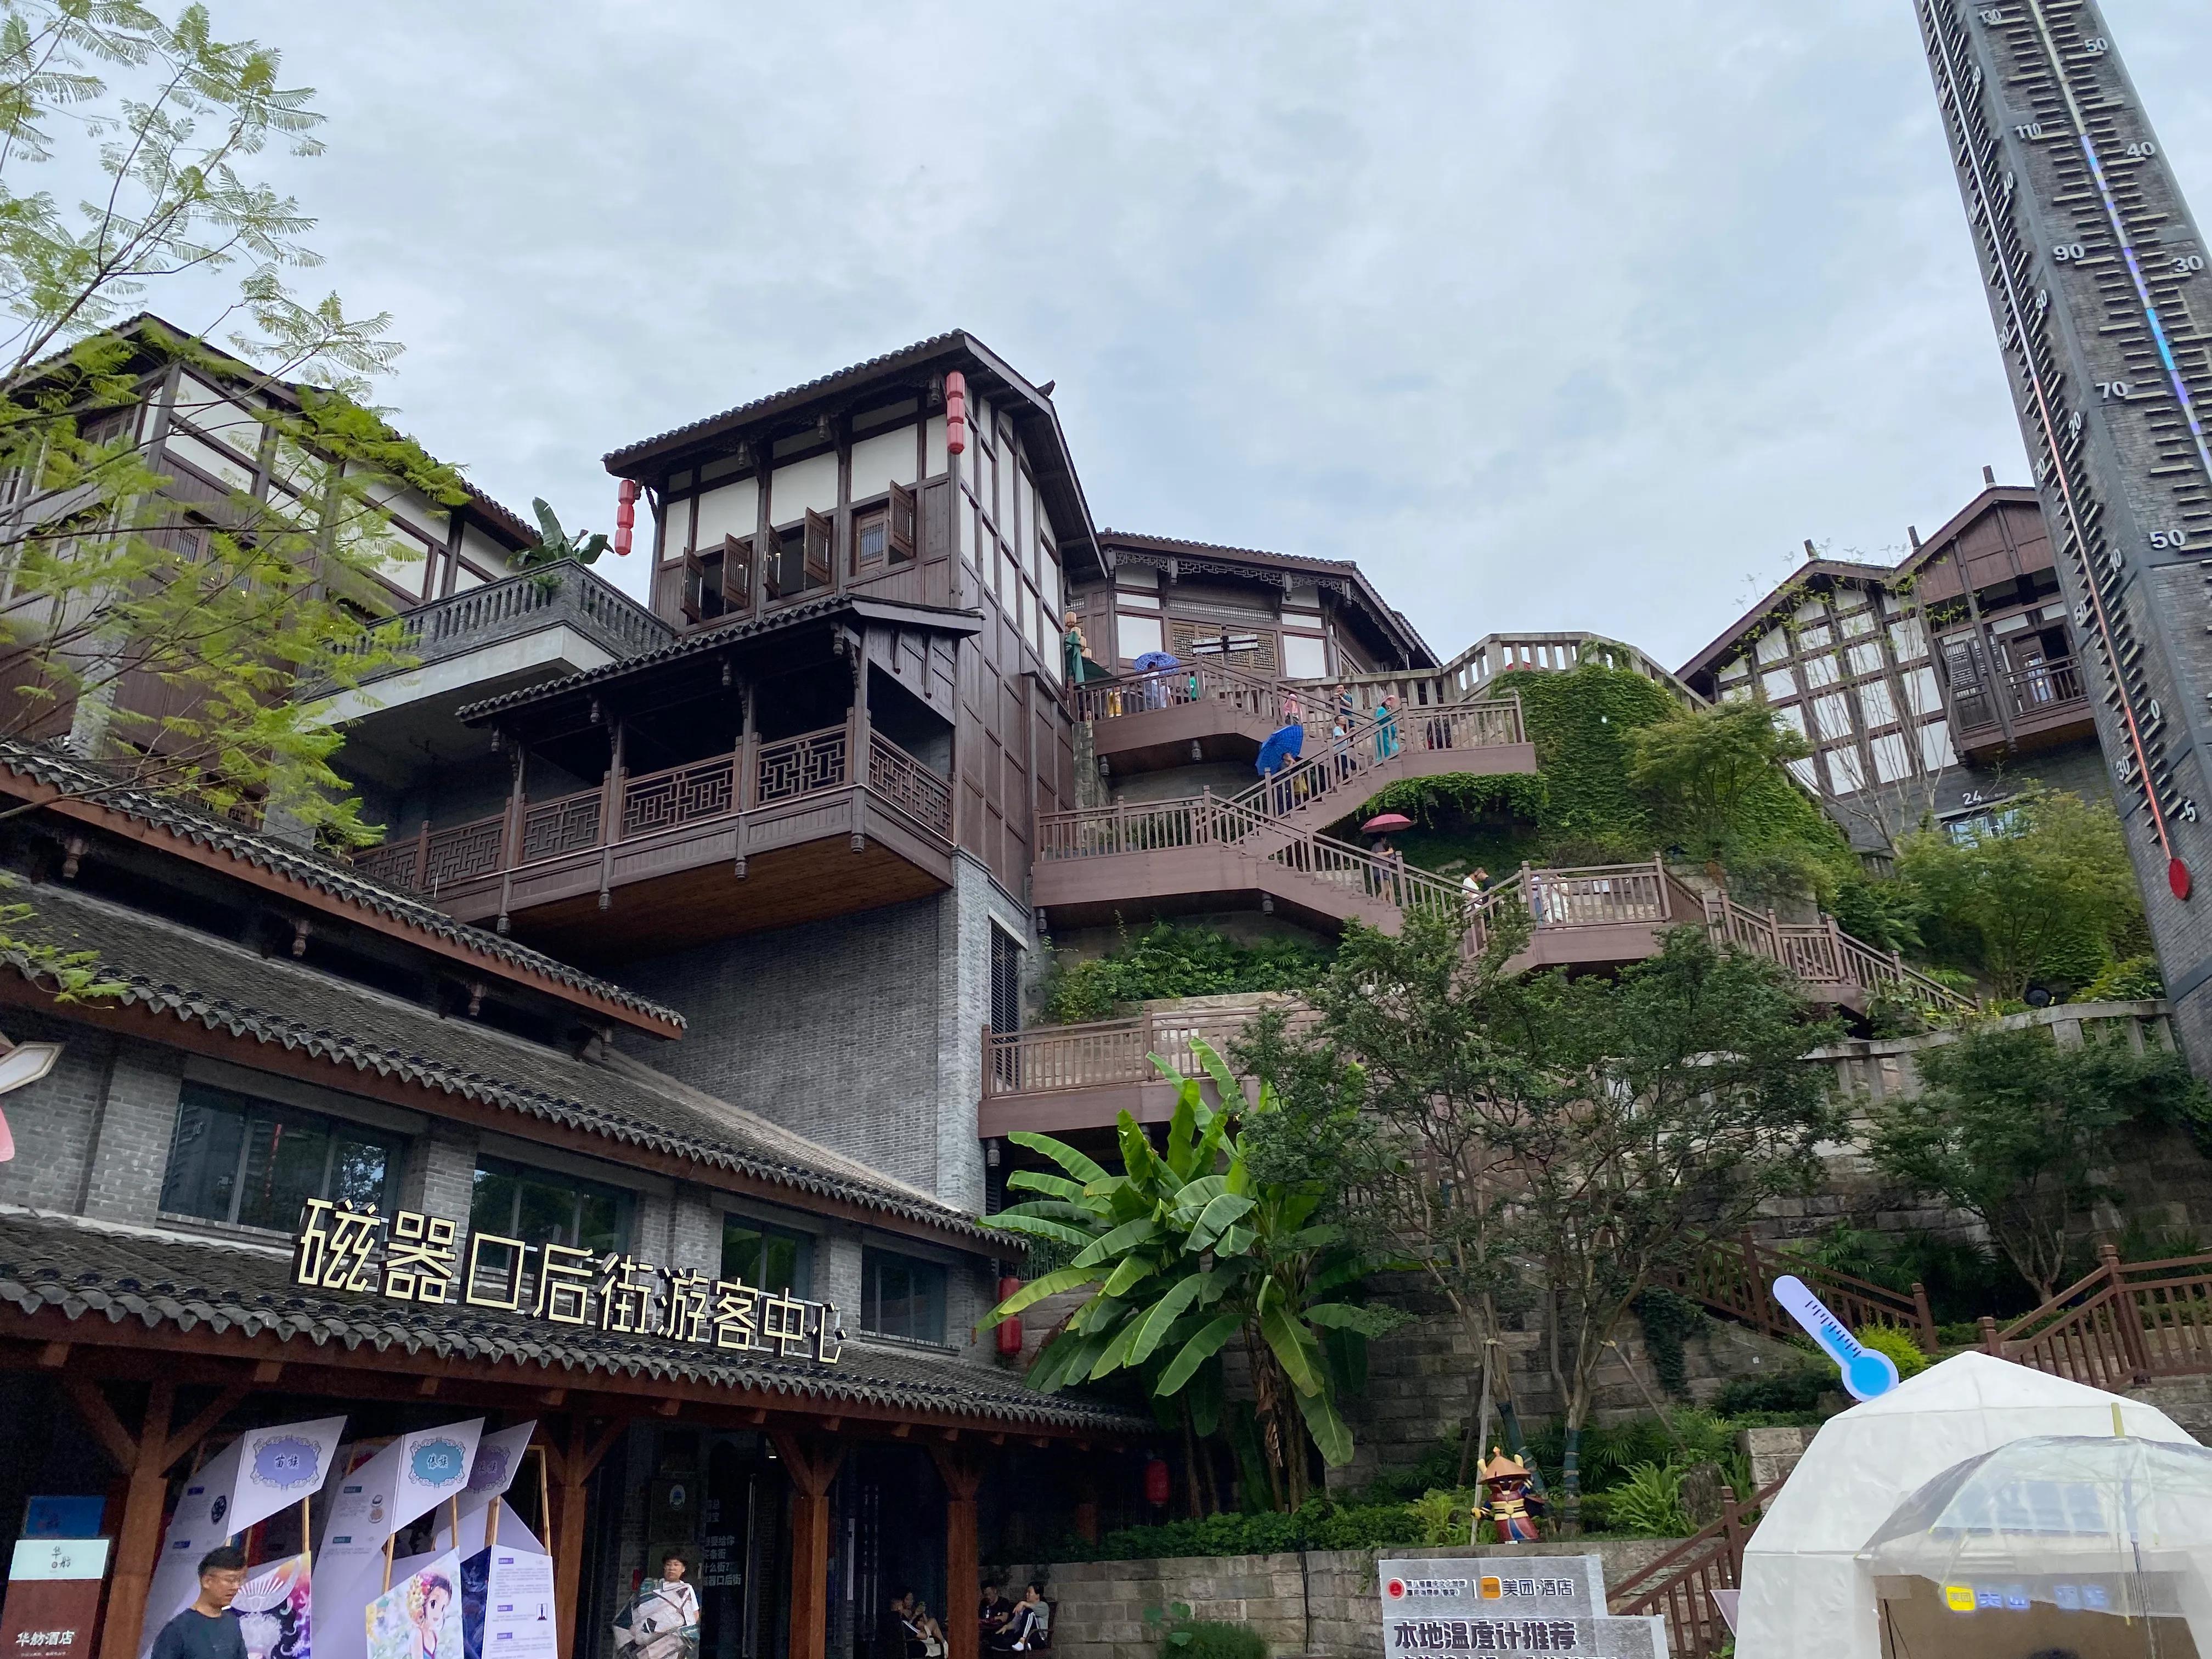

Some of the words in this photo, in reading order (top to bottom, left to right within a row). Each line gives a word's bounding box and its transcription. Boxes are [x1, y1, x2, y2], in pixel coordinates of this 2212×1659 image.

[1979, 9, 2002, 22] 130
[2085, 38, 2108, 52] 50
[2016, 123, 2041, 140] 110
[2126, 142, 2155, 157] 40
[2004, 171, 2013, 197] 40
[2053, 244, 2085, 261] 90
[2172, 256, 2204, 273] 30
[2096, 381, 2129, 399] 70
[2069, 411, 2081, 440] 20
[2149, 529, 2186, 549] 50
[2109, 549, 2121, 571] 10
[2150, 699, 2160, 720] 0
[2116, 755, 2130, 781] 30
[1962, 790, 1982, 805] 24
[294, 1198, 846, 1364] 磁器口后街游客中心
[274, 1454, 299, 1469] 苗族
[16, 1630, 75, 1647] 华舫酒店
[1394, 1621, 1578, 1650] 本地温度计推荐
